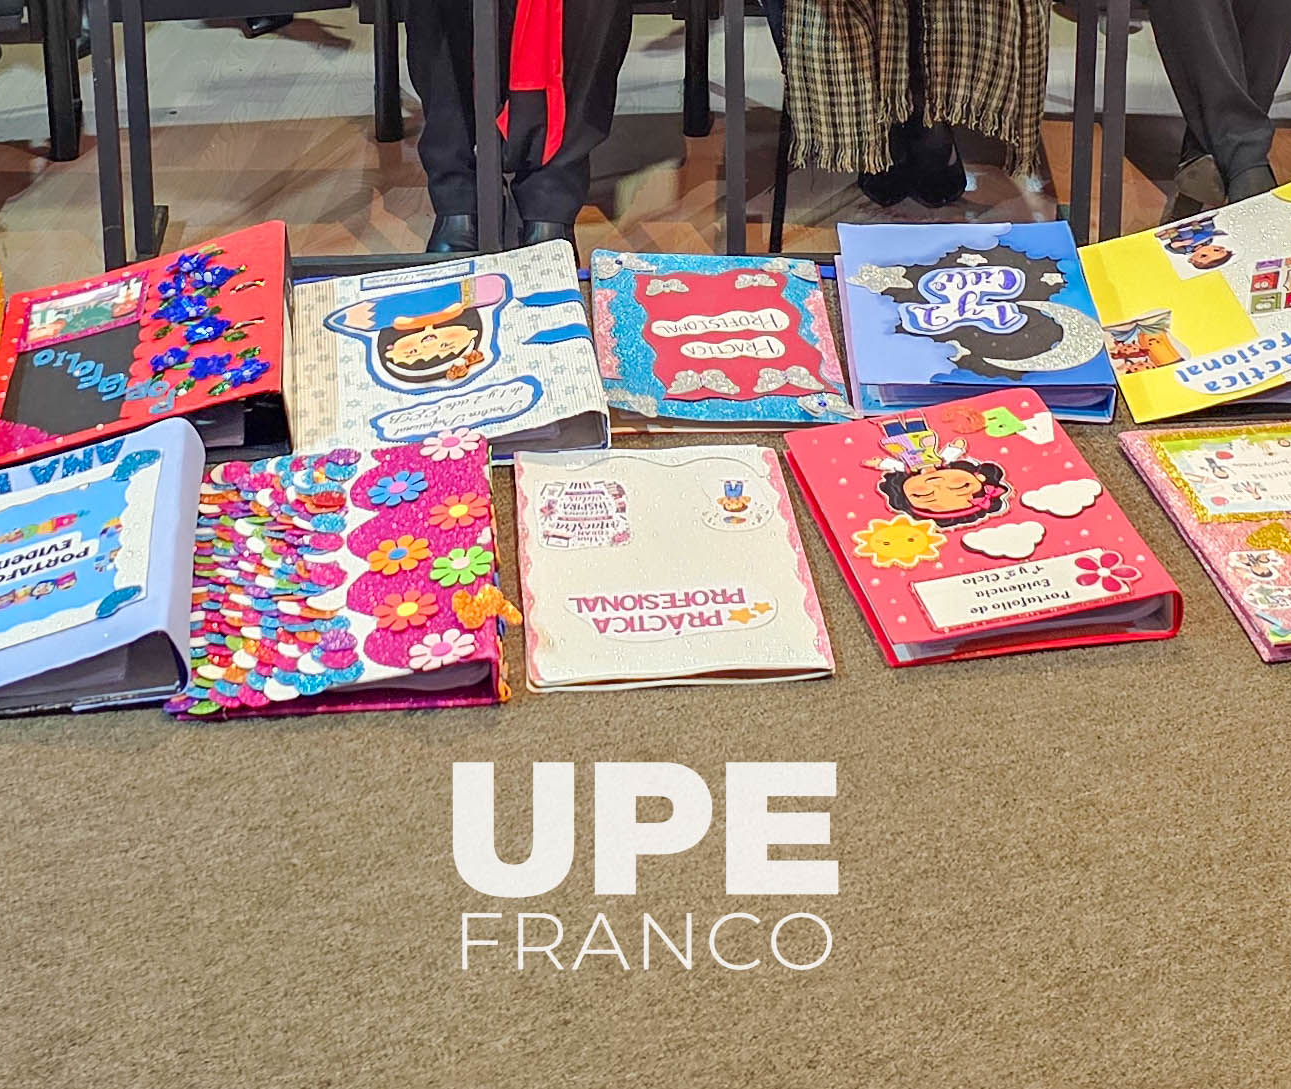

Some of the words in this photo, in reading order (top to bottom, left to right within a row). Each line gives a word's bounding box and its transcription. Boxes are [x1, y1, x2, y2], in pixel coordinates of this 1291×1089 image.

[656, 313, 783, 334] PROFESIONAL
[685, 340, 780, 358] PRACTICA
[975, 579, 1050, 597] Evidencia
[568, 588, 745, 613] PROFESIONAL
[991, 591, 1070, 610] Portafolio
[592, 609, 723, 635] PRÁCTICA
